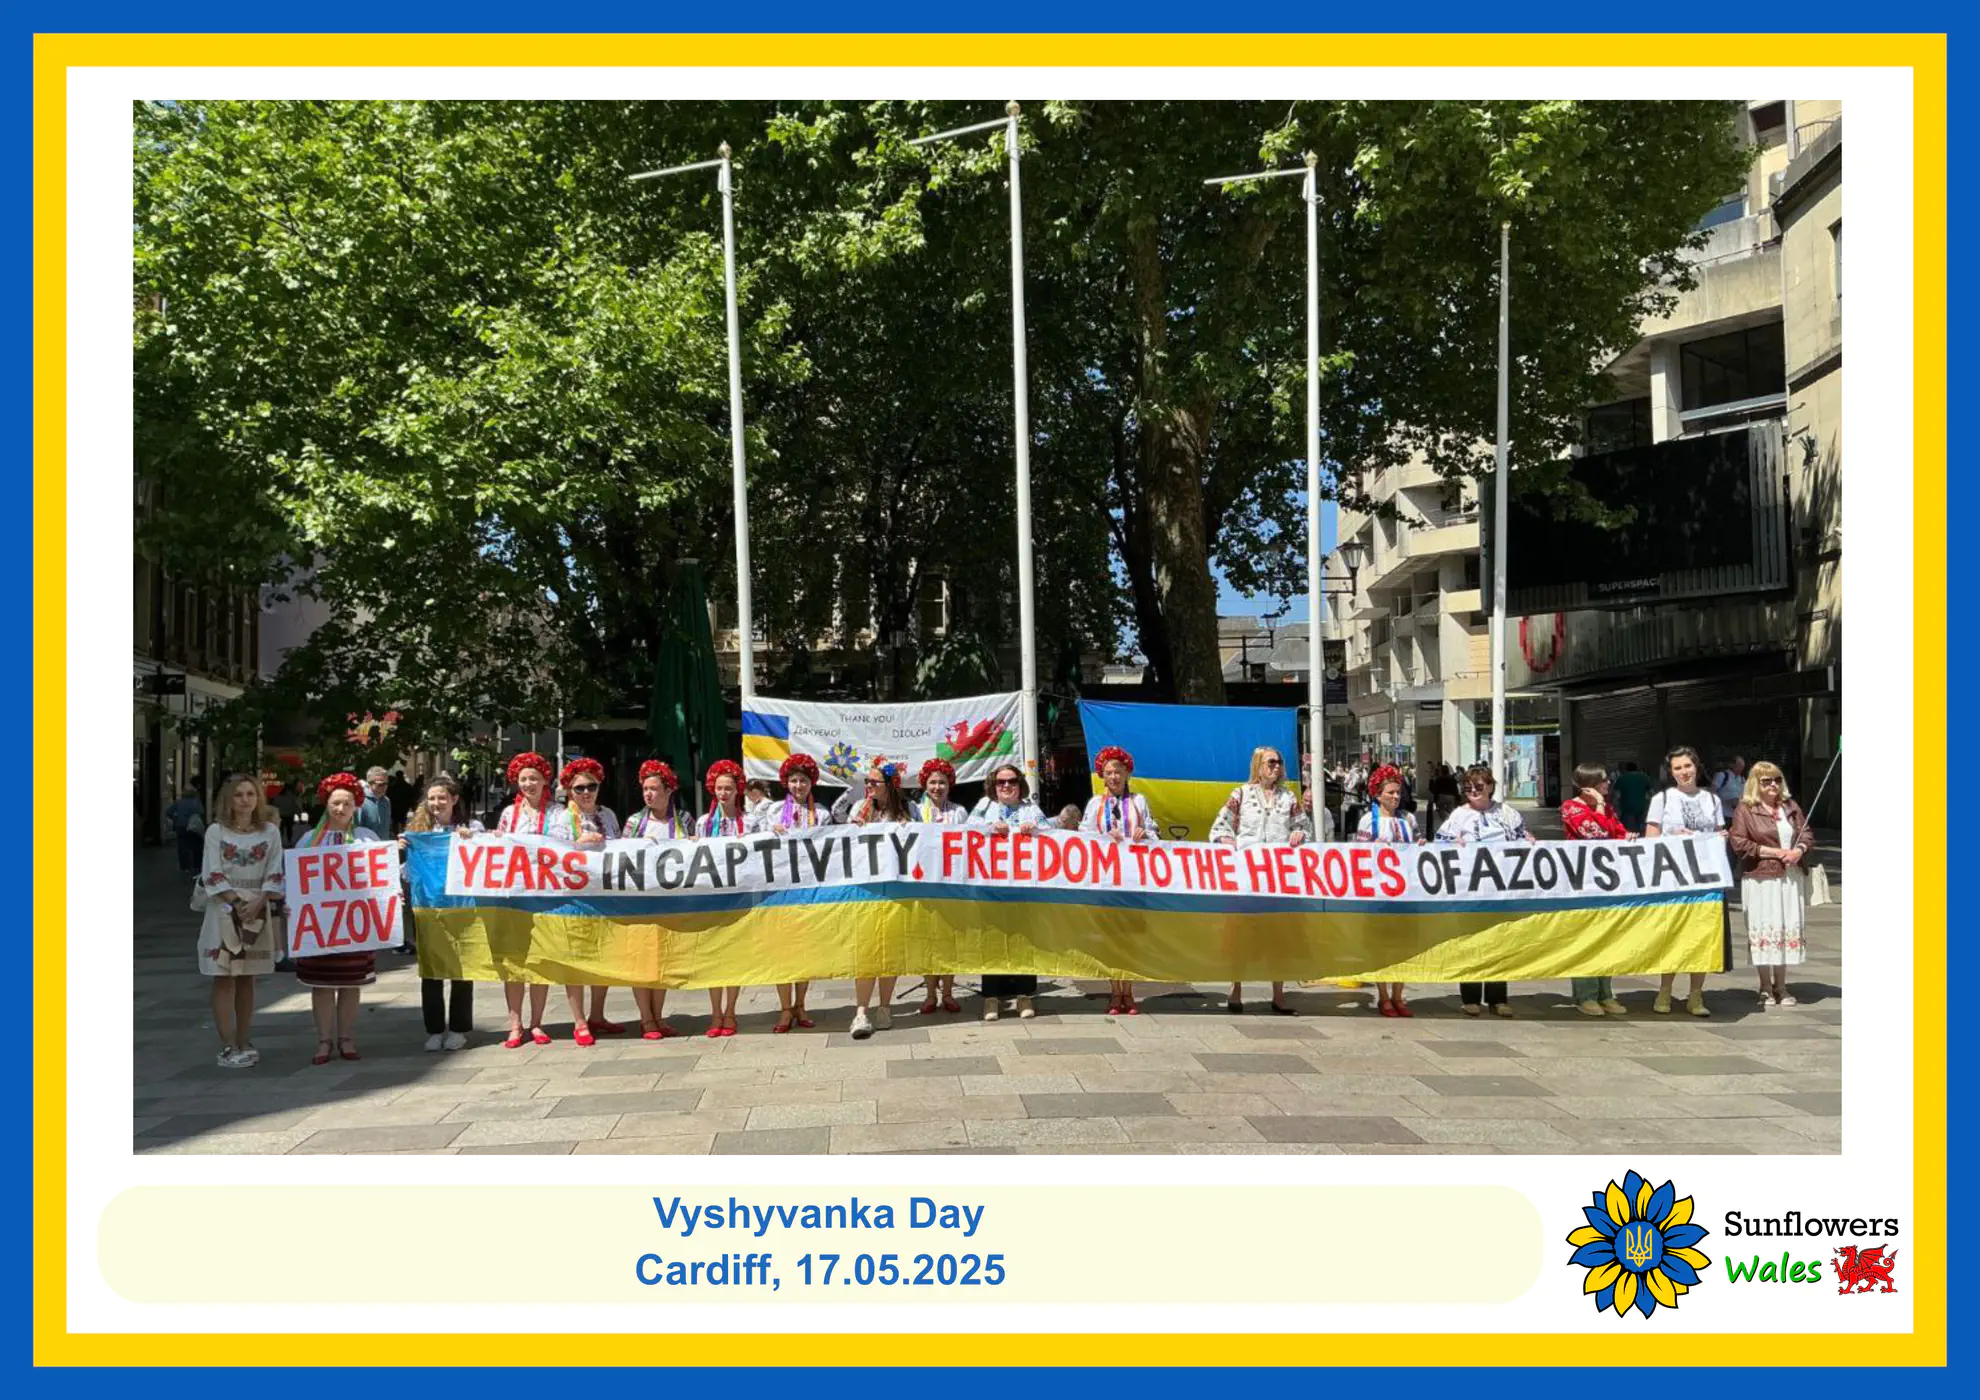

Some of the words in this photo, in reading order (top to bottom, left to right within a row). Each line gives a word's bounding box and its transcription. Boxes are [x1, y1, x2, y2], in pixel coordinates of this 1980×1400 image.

[840, 713, 871, 723] THANK
[873, 713, 895, 723] YOU!
[892, 726, 931, 738] DIOLCH!
[297, 848, 389, 895] FREE
[458, 845, 590, 891] YEARS
[602, 849, 646, 892] IN
[942, 831, 1122, 887] FREEDOM
[1129, 844, 1173, 888] TO
[1173, 847, 1239, 893] THE
[1245, 846, 1406, 898] HEROES
[1417, 850, 1461, 895] OF
[1468, 839, 1721, 893] AZOVSTAL
[292, 895, 398, 951] AZOV
